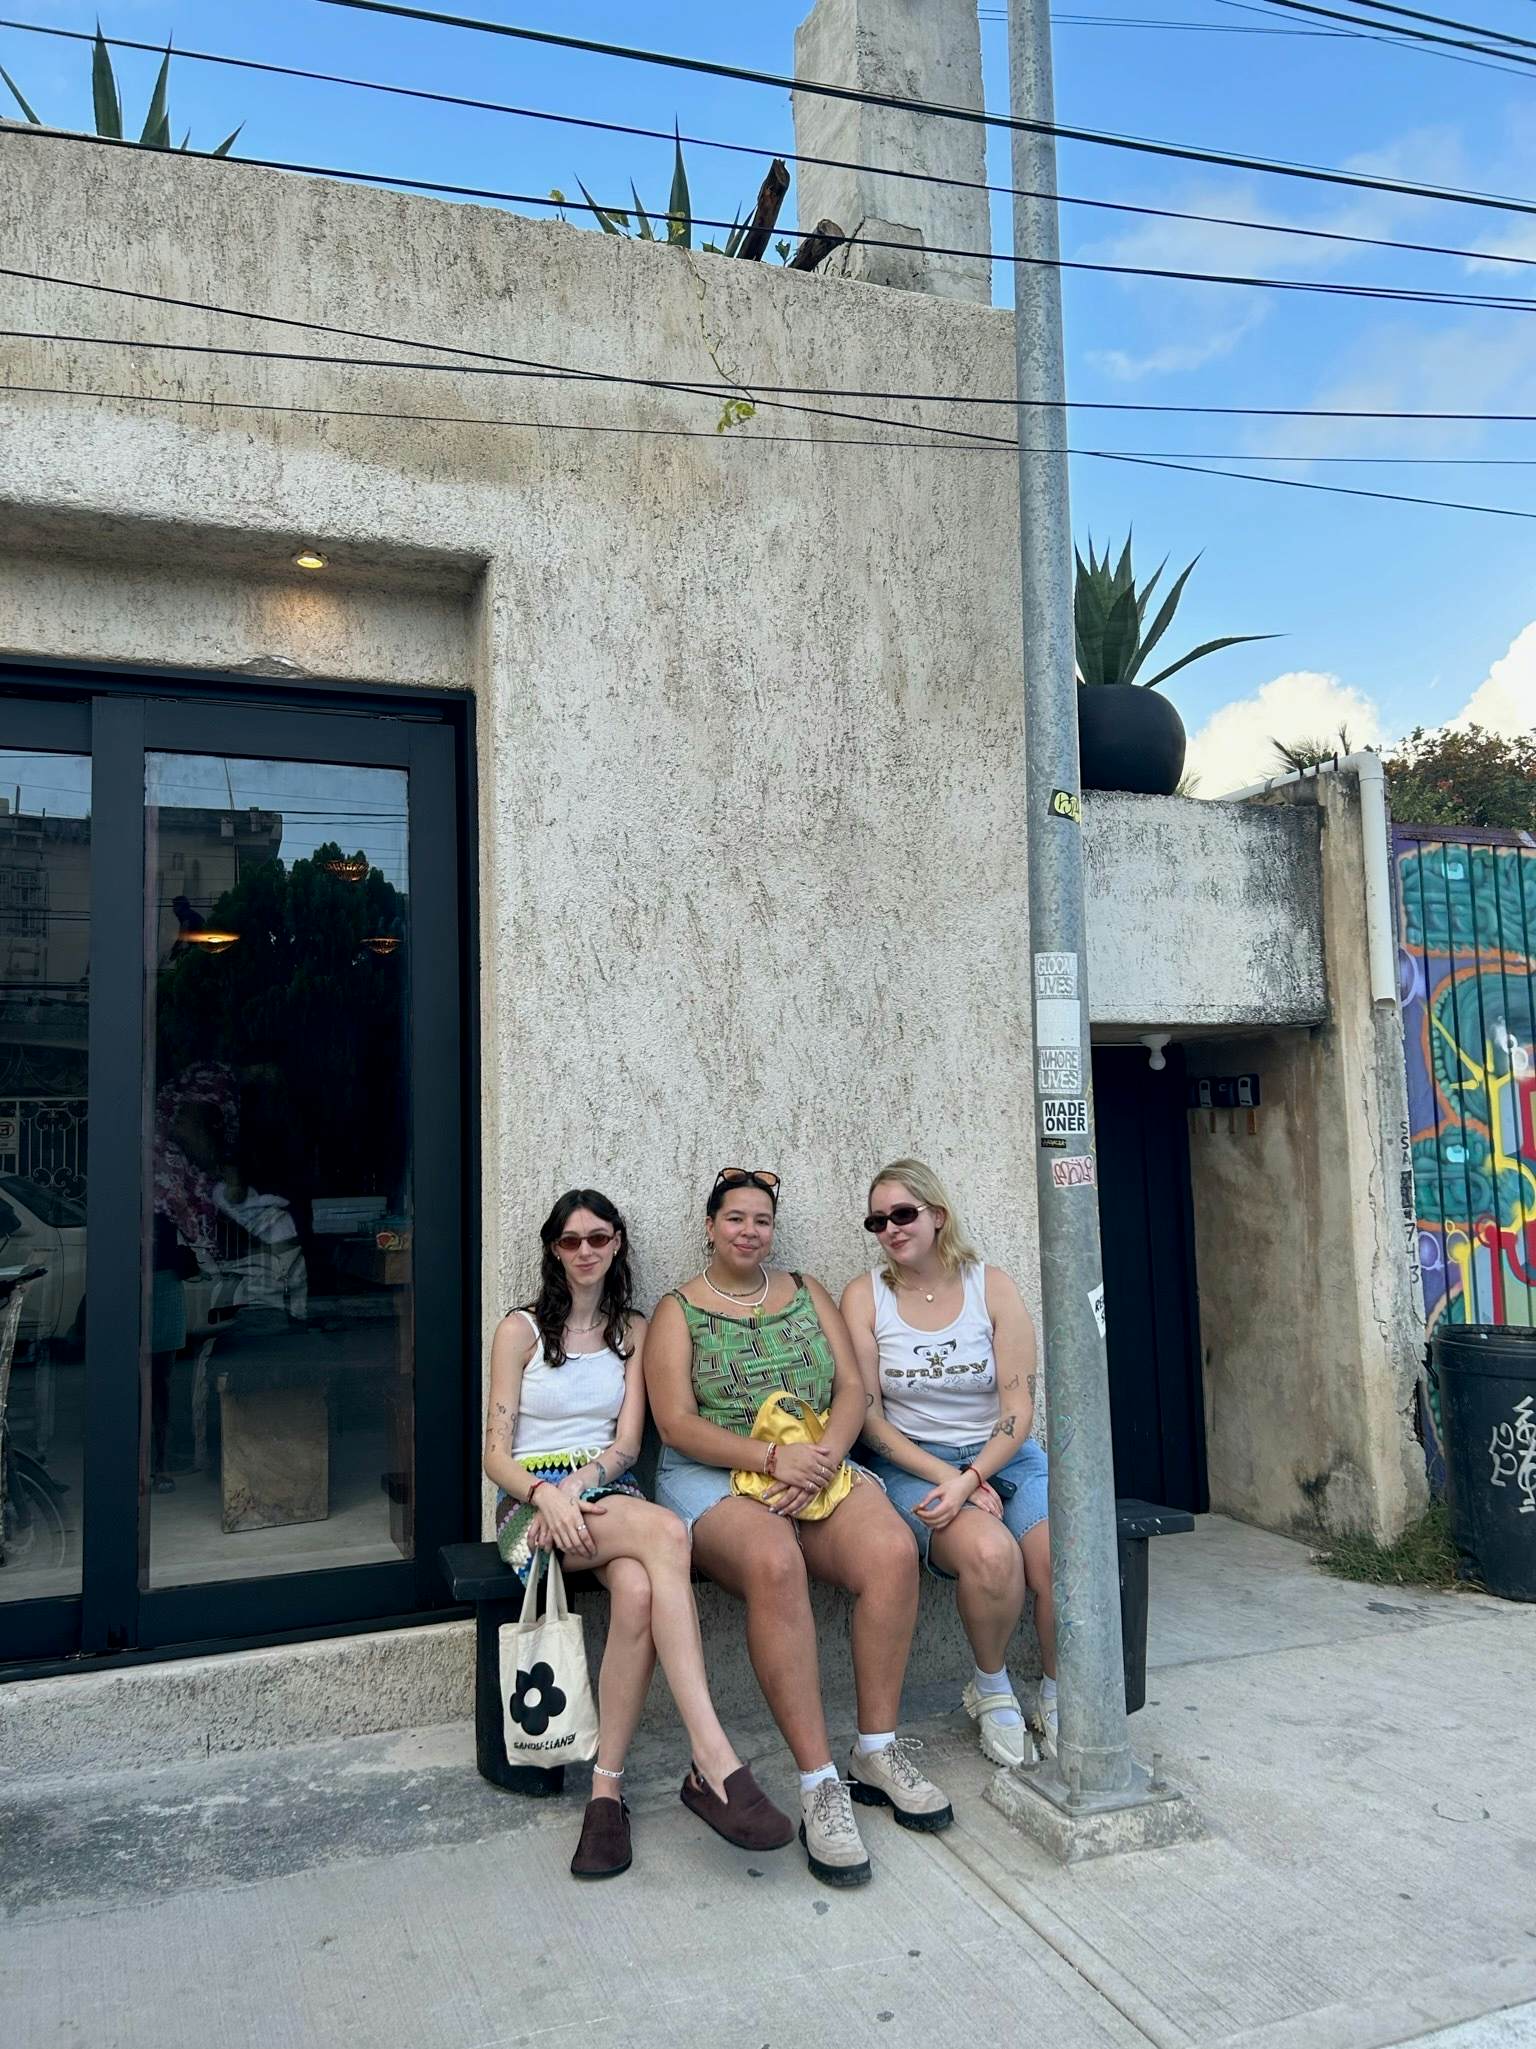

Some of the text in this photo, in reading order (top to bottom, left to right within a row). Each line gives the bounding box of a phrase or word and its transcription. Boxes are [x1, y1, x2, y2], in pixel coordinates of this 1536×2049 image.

[1039, 976, 1073, 994] LIVES
[1040, 1050, 1078, 1069] WHORE
[1041, 1070, 1078, 1089] LIVES
[1045, 1102, 1086, 1117] MADE
[1046, 1117, 1086, 1132] ONER
[884, 1358, 989, 1379] enjoy
